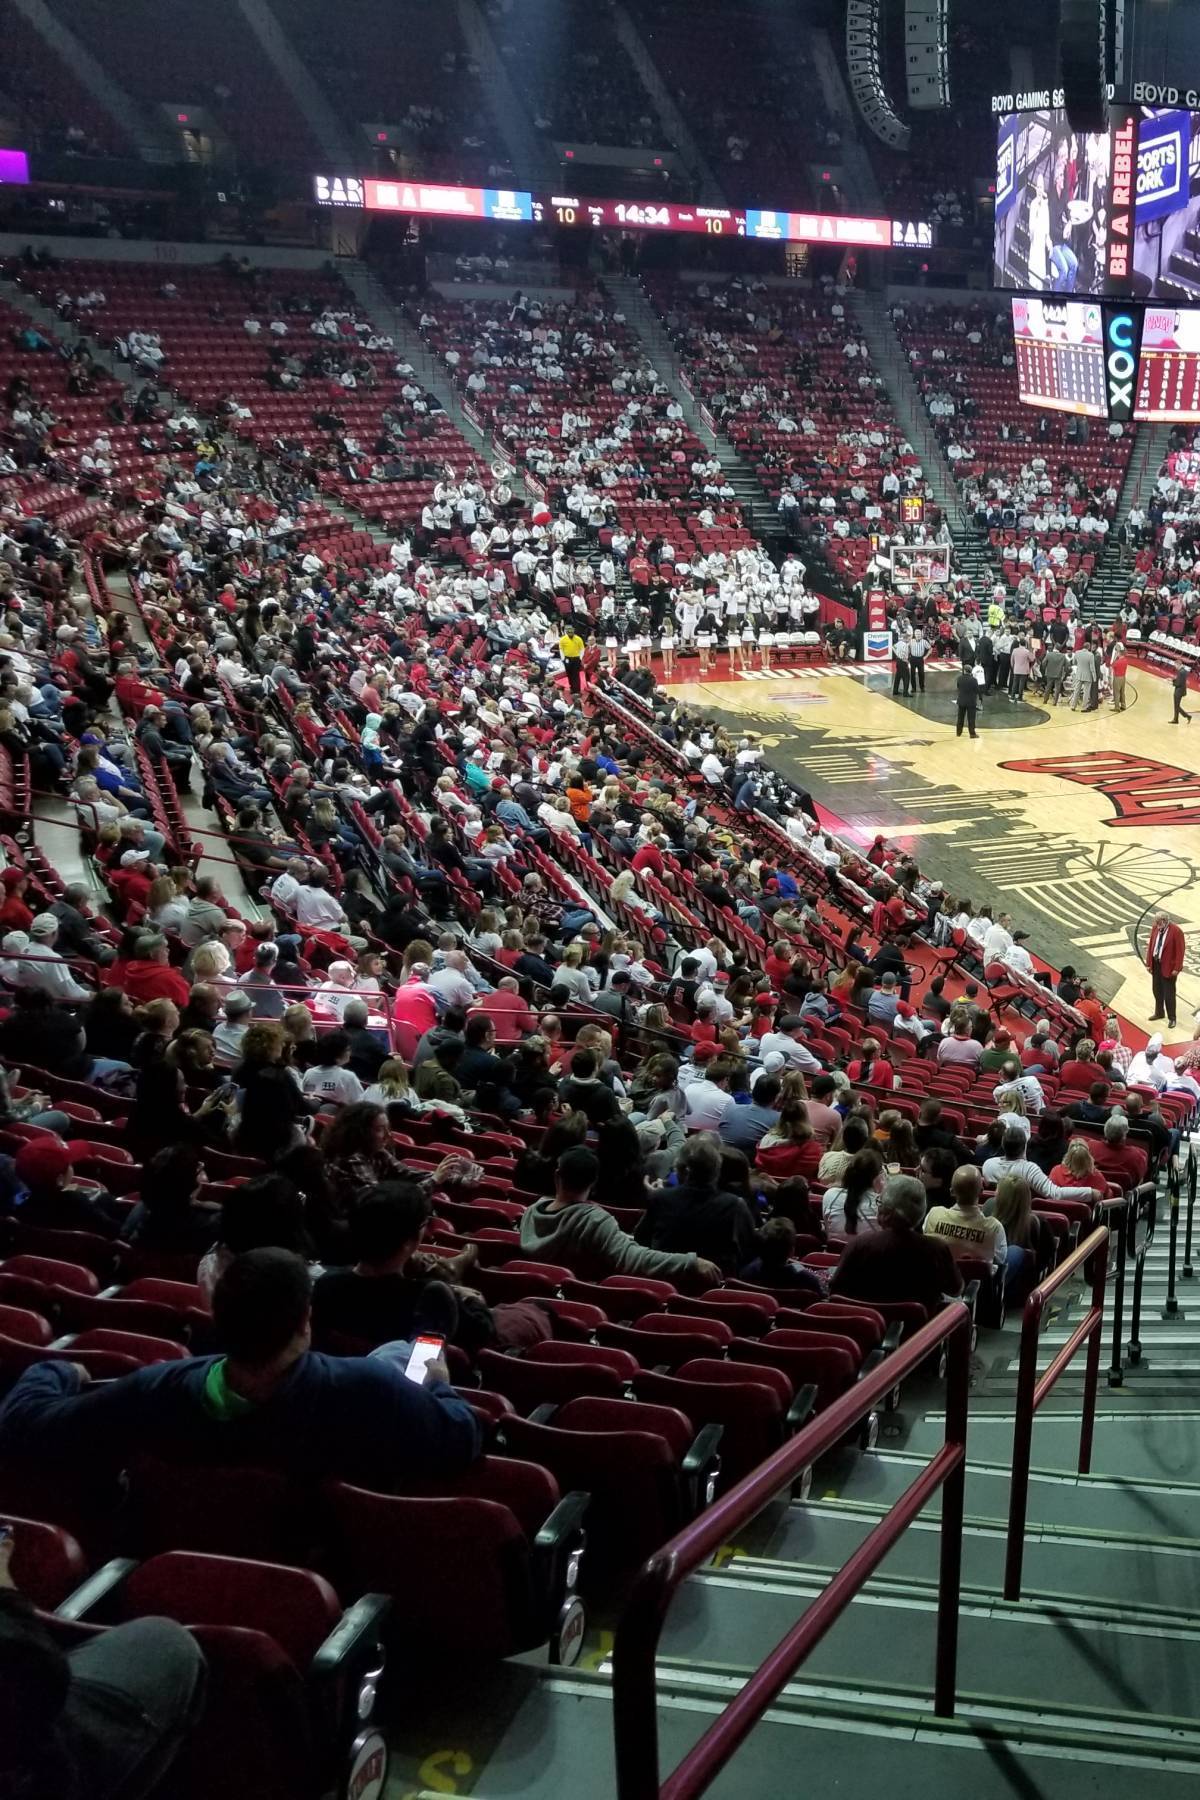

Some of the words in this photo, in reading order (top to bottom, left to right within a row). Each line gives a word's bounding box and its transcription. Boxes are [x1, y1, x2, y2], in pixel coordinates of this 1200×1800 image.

[992, 94, 1013, 112] BOYD
[1015, 89, 1050, 110] GAMING
[1134, 83, 1178, 105] BOYD
[1112, 117, 1135, 205] REBEL.
[534, 210, 542, 221] 3
[556, 207, 575, 223] 10
[592, 214, 600, 226] 2
[614, 203, 671, 226] 14:34
[1111, 214, 1130, 236] A
[705, 218, 723, 234] 10
[1109, 244, 1128, 276] BE
[1108, 316, 1135, 407] COX
[905, 506, 920, 520] 30
